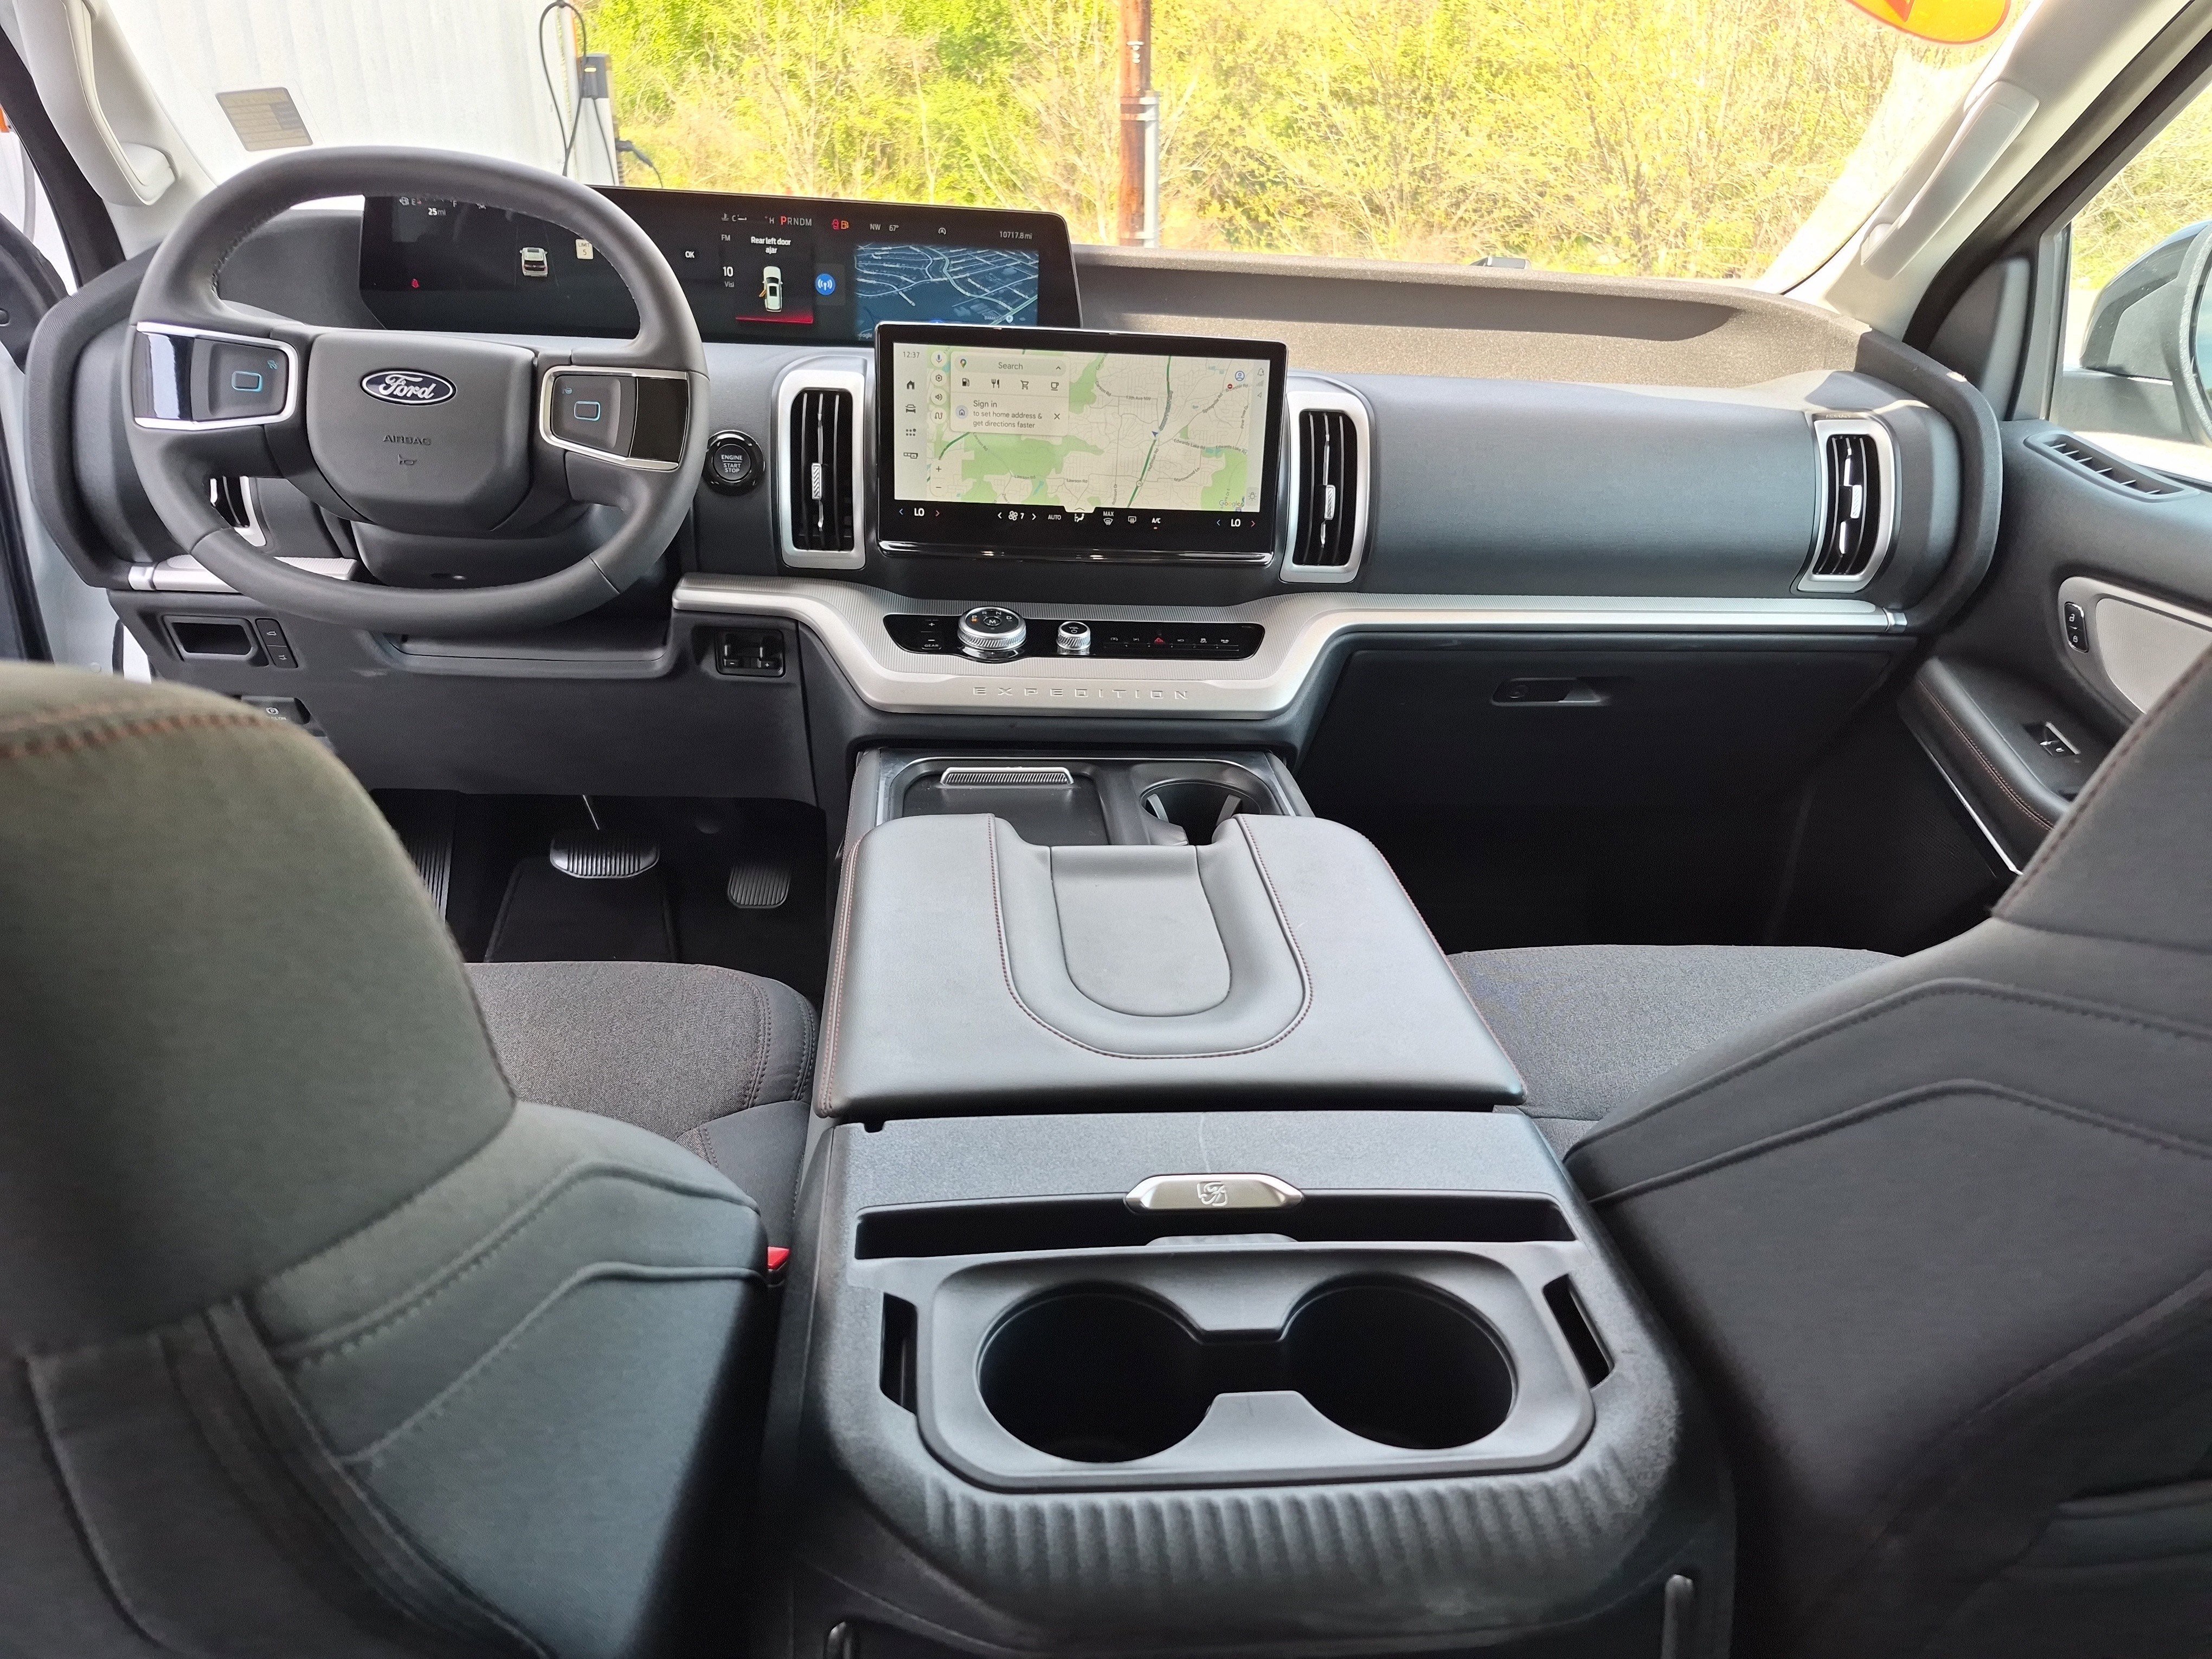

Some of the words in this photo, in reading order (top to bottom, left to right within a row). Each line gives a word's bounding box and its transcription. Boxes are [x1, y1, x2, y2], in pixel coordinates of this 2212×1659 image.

[685, 250, 695, 259] OK
[723, 266, 734, 277] 10
[998, 362, 1023, 370] Search
[378, 374, 436, 399] Ford
[973, 400, 989, 408] Sign
[1219, 500, 1242, 508] Google
[914, 507, 925, 517] LO
[1231, 518, 1241, 527] LO
[973, 686, 1188, 700] EXPEDITION
